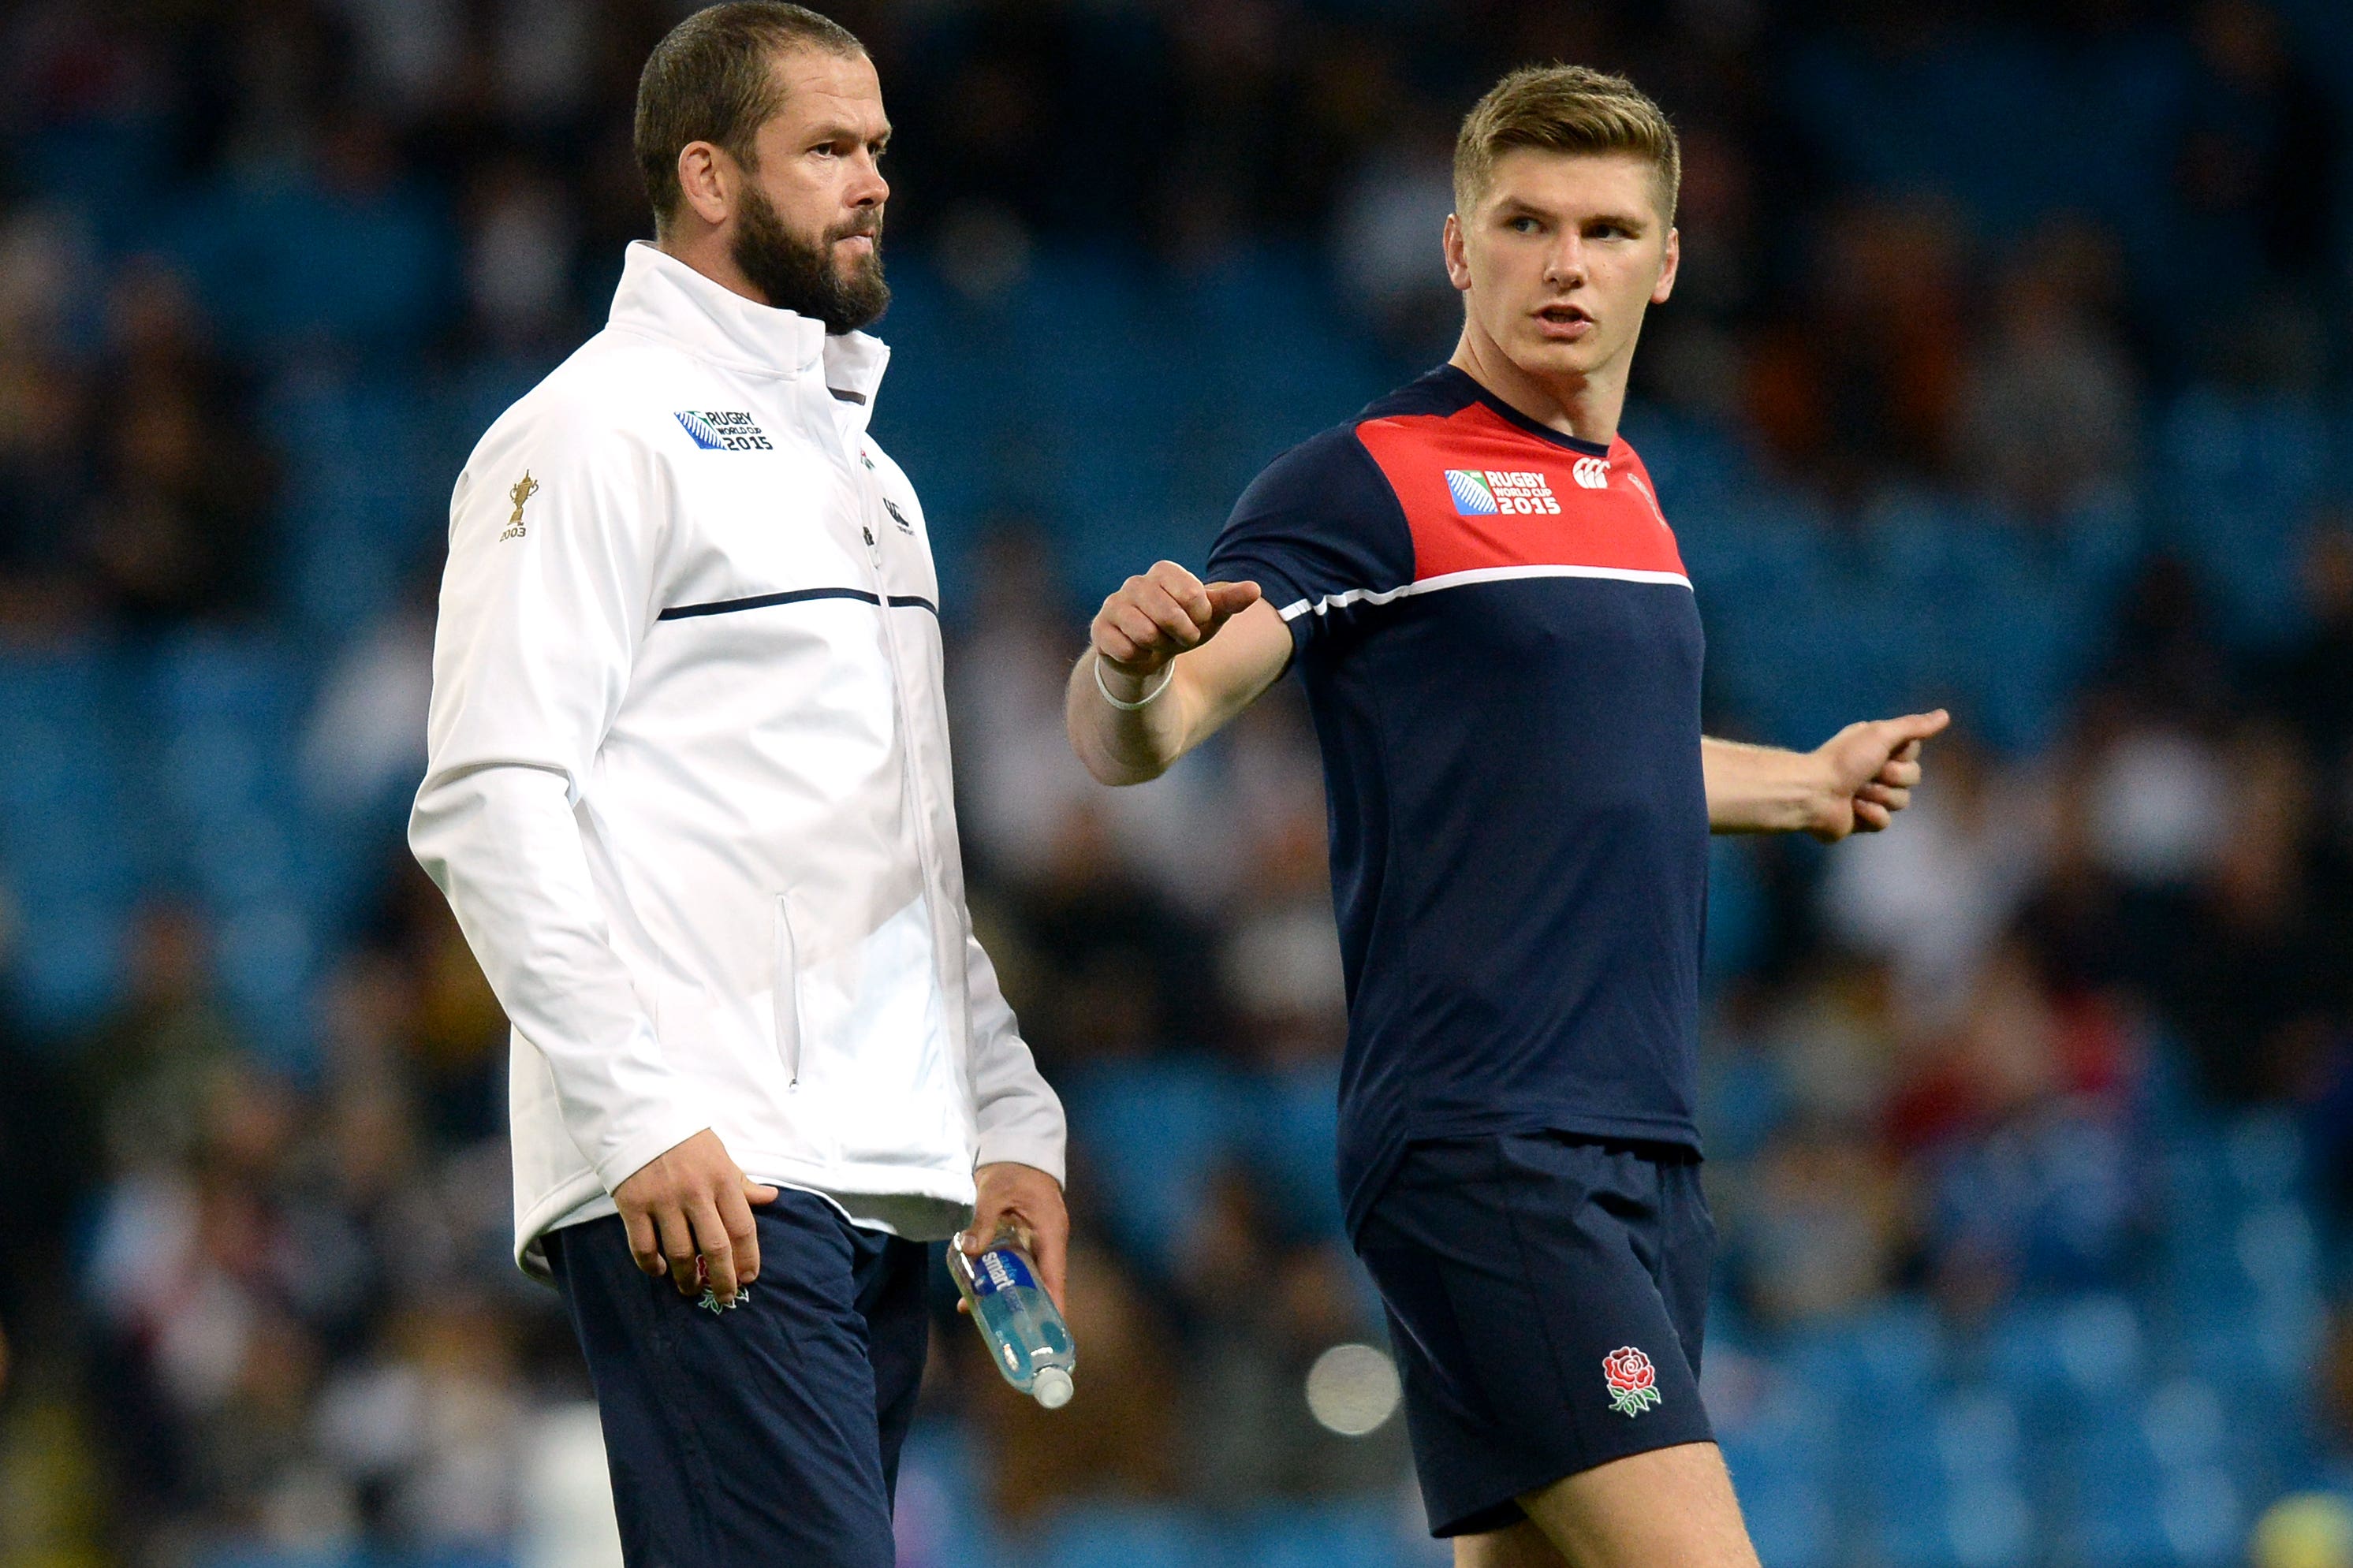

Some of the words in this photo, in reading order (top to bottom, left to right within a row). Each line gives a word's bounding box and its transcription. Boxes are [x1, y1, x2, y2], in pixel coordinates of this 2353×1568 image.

[705, 412, 755, 426] RUGBY
[716, 426, 748, 435] WORLD
[722, 436, 774, 451] 2015
[1484, 471, 1546, 488] RUGBY
[1492, 487, 1531, 497] WORLD
[1531, 488, 1553, 497] CUP
[1497, 497, 1561, 515] 2015
[499, 527, 526, 542] 2003
